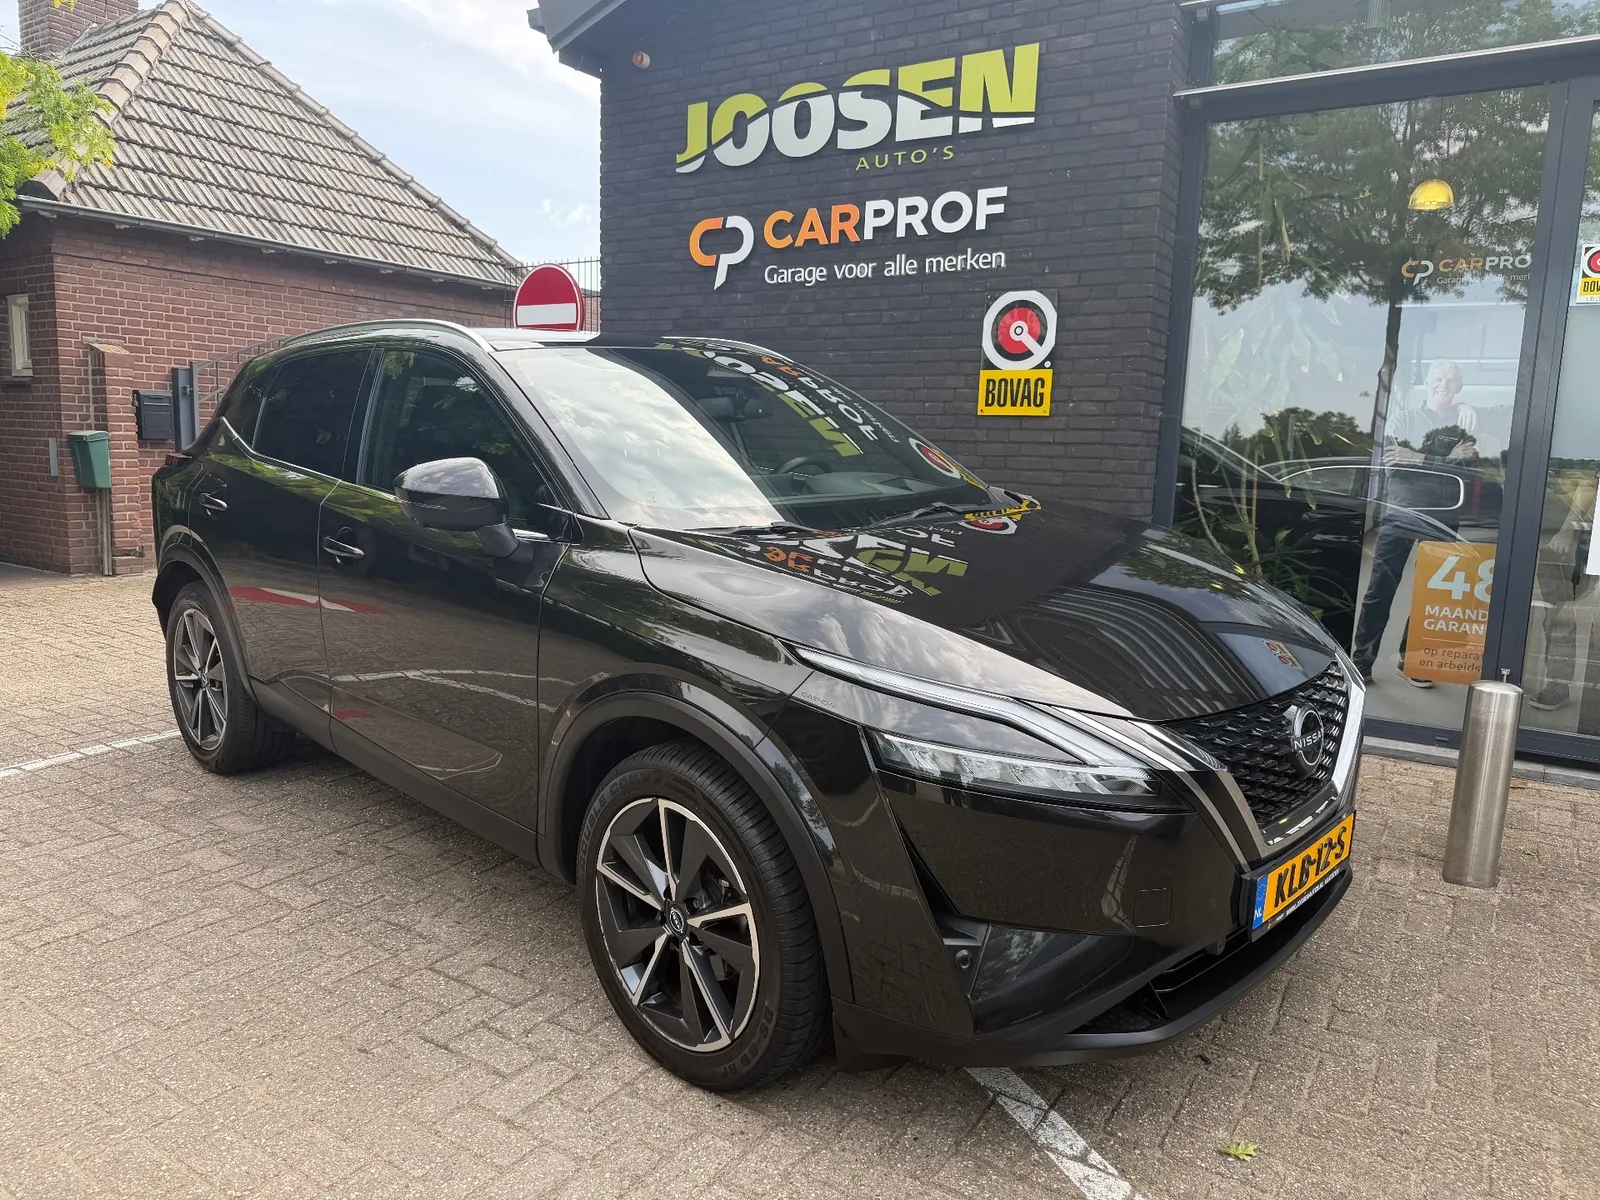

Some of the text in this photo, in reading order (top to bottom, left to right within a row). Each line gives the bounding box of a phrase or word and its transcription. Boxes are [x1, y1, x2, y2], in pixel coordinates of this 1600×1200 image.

[676, 43, 1040, 173] JOOSEN
[855, 145, 954, 171] AUTO'S
[763, 186, 1008, 249] CARPROF
[764, 248, 1006, 287] Garage voor alle merken
[984, 377, 1045, 408] BOVAG
[1424, 618, 1487, 635] GARAN
[1425, 605, 1488, 622] MAAND
[1419, 659, 1481, 673] en arbeids
[1423, 647, 1482, 660] op repara
[1273, 826, 1347, 908] KLB-12-S
[1254, 906, 1263, 920] NL
